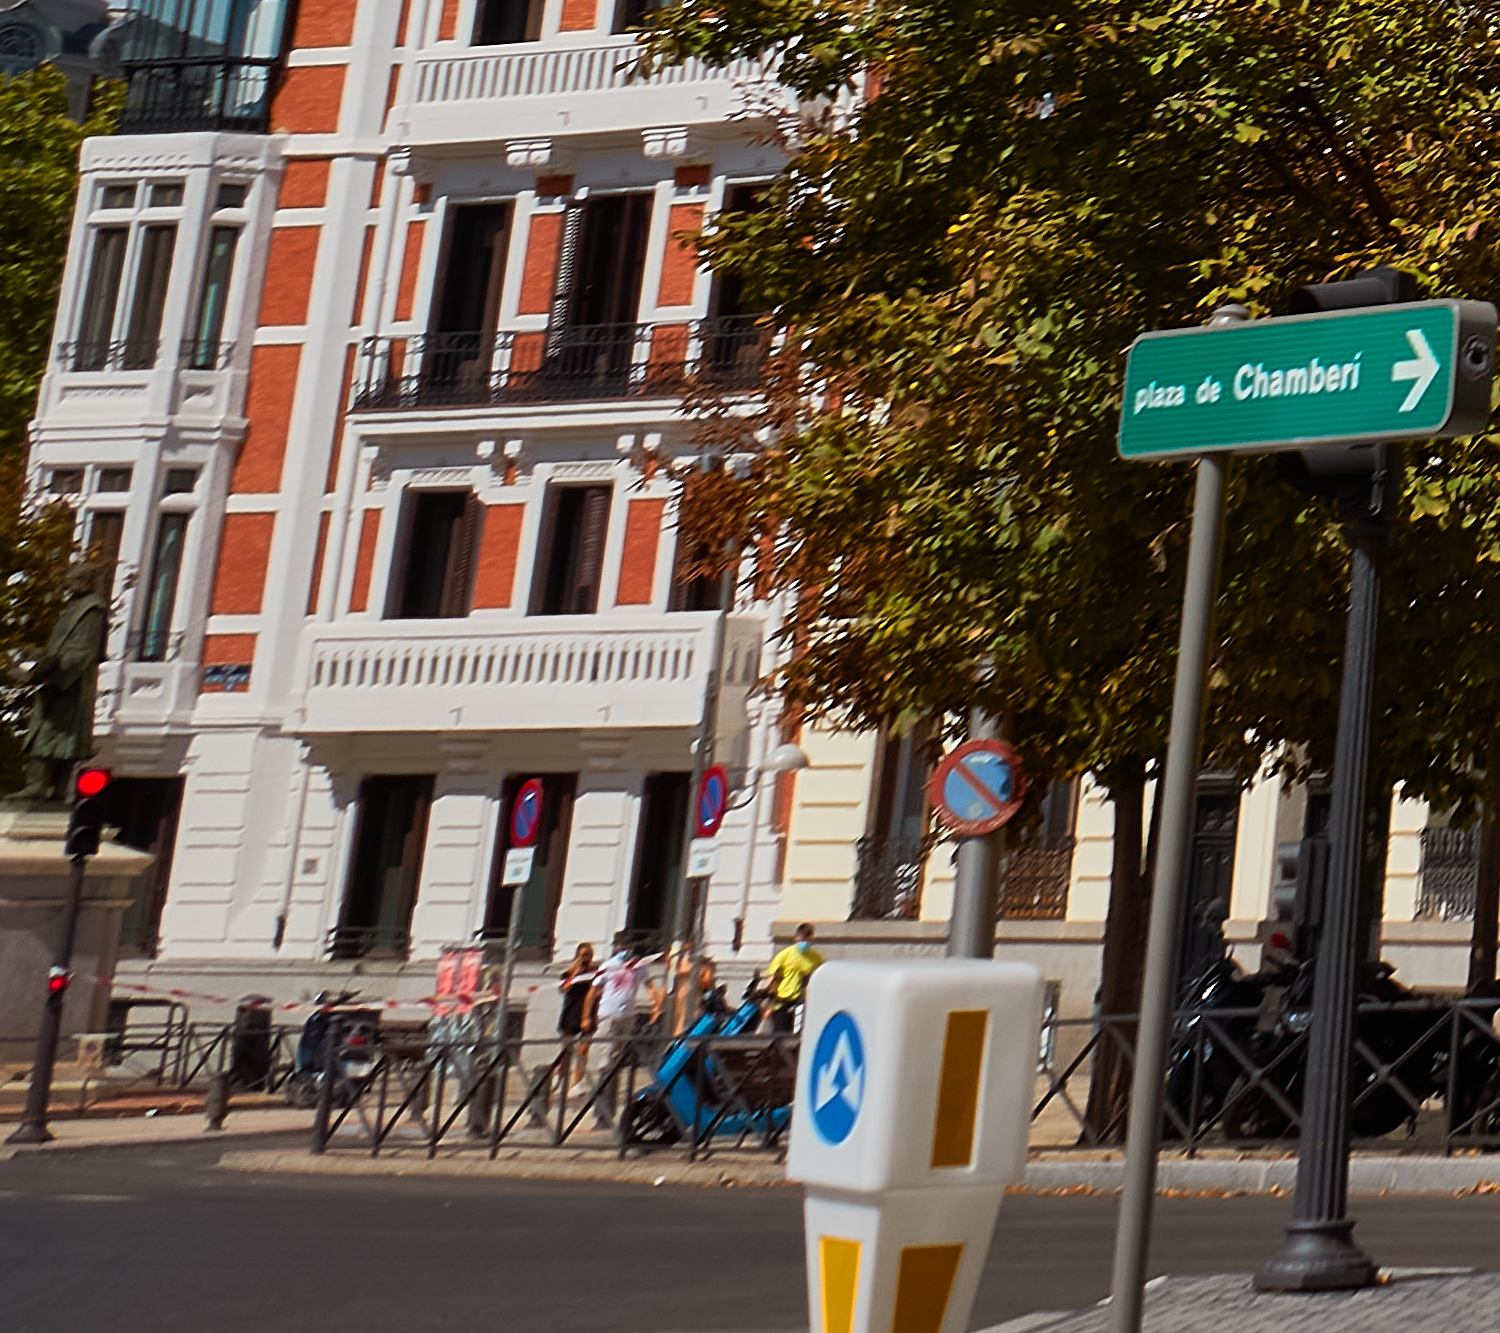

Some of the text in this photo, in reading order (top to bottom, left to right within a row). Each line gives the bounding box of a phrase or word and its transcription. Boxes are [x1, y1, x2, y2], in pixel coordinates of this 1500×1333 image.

[1133, 351, 1363, 415] plaza de Chamberí
